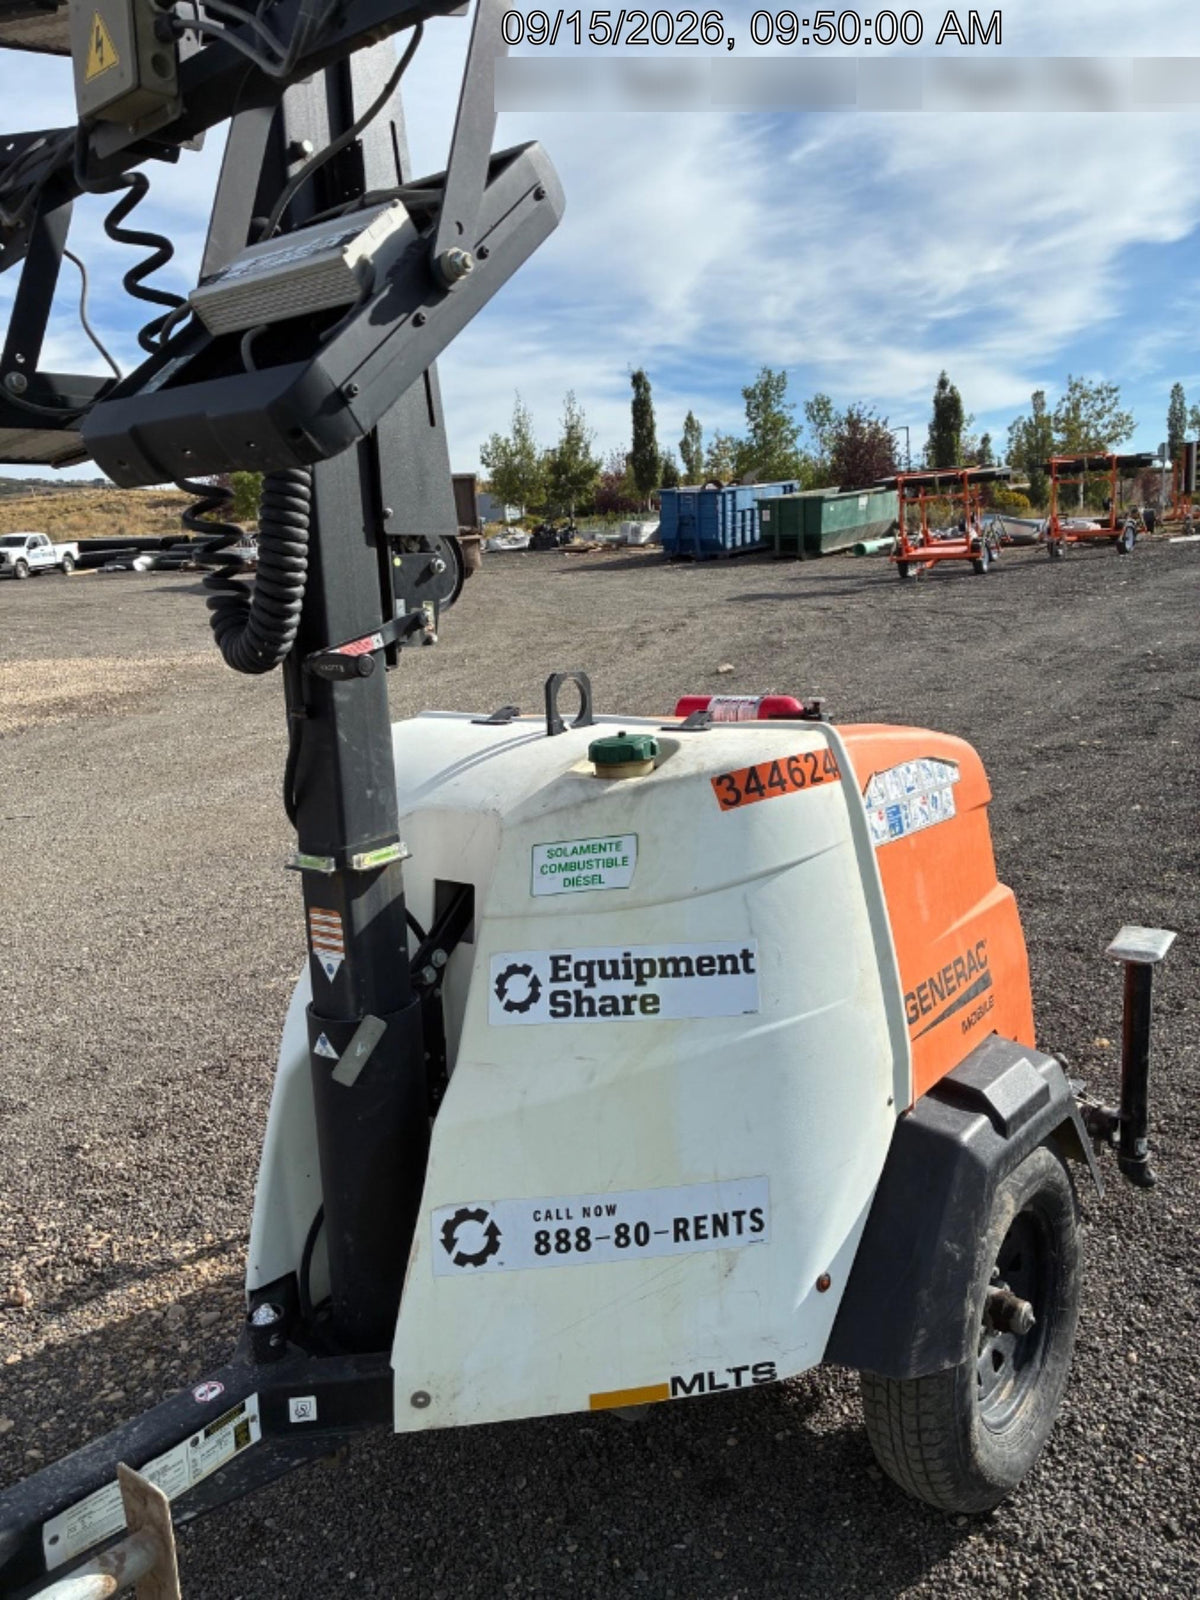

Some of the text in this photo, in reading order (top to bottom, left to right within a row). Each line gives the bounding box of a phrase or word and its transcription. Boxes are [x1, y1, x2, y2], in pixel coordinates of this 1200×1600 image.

[716, 748, 838, 806] 344624
[540, 856, 629, 875] COMBUSTIBLE
[546, 841, 623, 859] SOLAMENTE
[549, 948, 755, 988] Equipment
[904, 939, 988, 1025] GENERAC
[549, 989, 660, 1018] Share
[961, 994, 995, 1035] MOBILE
[533, 1204, 618, 1222] CALL NOW
[534, 1207, 766, 1256] 888-80-RENTS
[670, 1361, 777, 1397] MLTS
